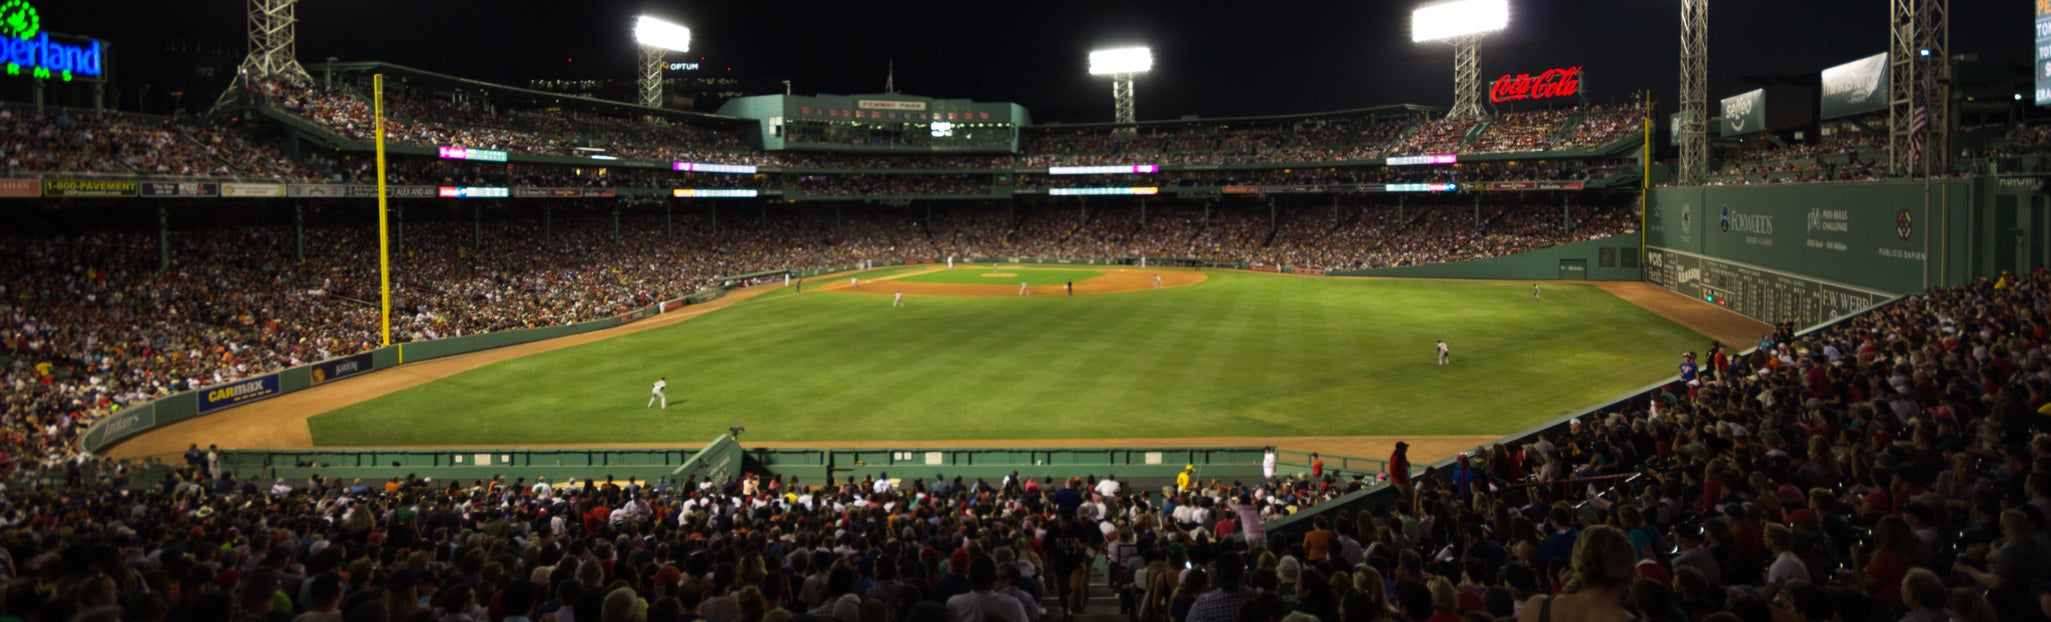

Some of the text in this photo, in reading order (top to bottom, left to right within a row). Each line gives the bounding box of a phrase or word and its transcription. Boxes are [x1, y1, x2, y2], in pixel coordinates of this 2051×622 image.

[670, 62, 699, 71] OPTUM
[1490, 66, 1583, 103] Coca-Cola
[47, 180, 135, 190] 1-800-PAVEMENT
[1731, 210, 1773, 235] FOXWOODS
[1879, 248, 1927, 262] PUBLICIS.SAPIEN
